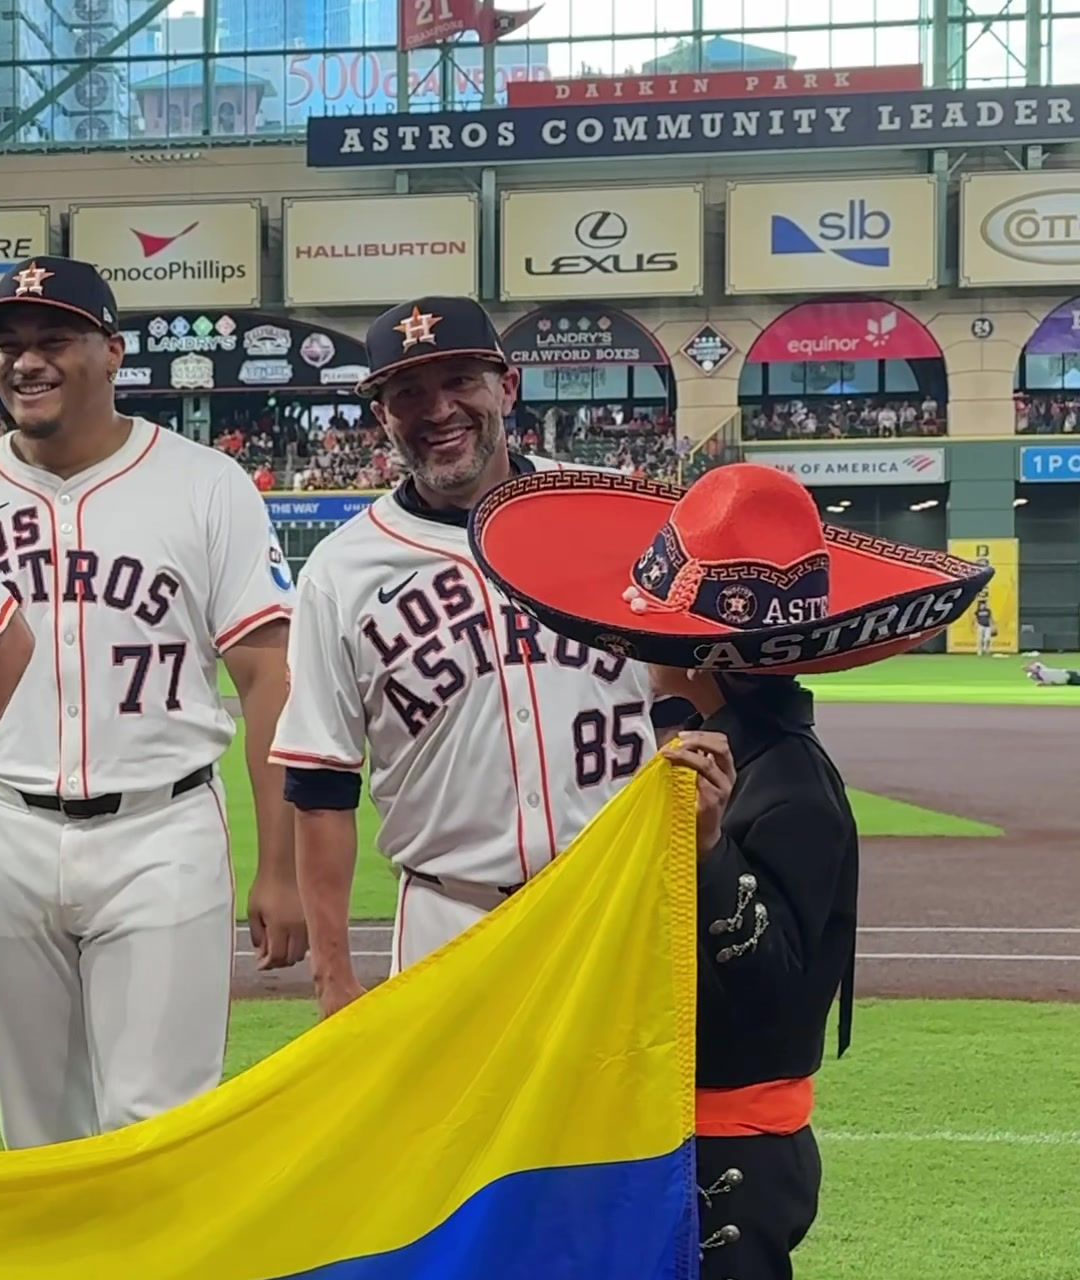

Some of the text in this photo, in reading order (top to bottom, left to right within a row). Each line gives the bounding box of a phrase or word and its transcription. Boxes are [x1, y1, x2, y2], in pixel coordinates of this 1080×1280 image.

[287, 52, 381, 107] 500
[556, 72, 852, 99] DAIKIN PARK
[340, 97, 1075, 153] ASTROS COMMUNITY LEADER
[819, 199, 890, 241] slb
[296, 241, 467, 259] HALLIBURTON
[525, 252, 679, 276] LEXUS
[147, 335, 236, 353] LANDRY'S
[536, 331, 613, 345] LANDRY'S
[787, 334, 860, 356] equinor
[511, 348, 640, 362] CRAWFORD BOXES
[800, 463, 820, 474] OF
[825, 462, 899, 474] AMERICA
[270, 503, 320, 514] THE WAY
[362, 566, 476, 667] LOS
[695, 587, 962, 669] ASTROS
[111, 641, 186, 715] 77
[572, 701, 645, 789] 85
